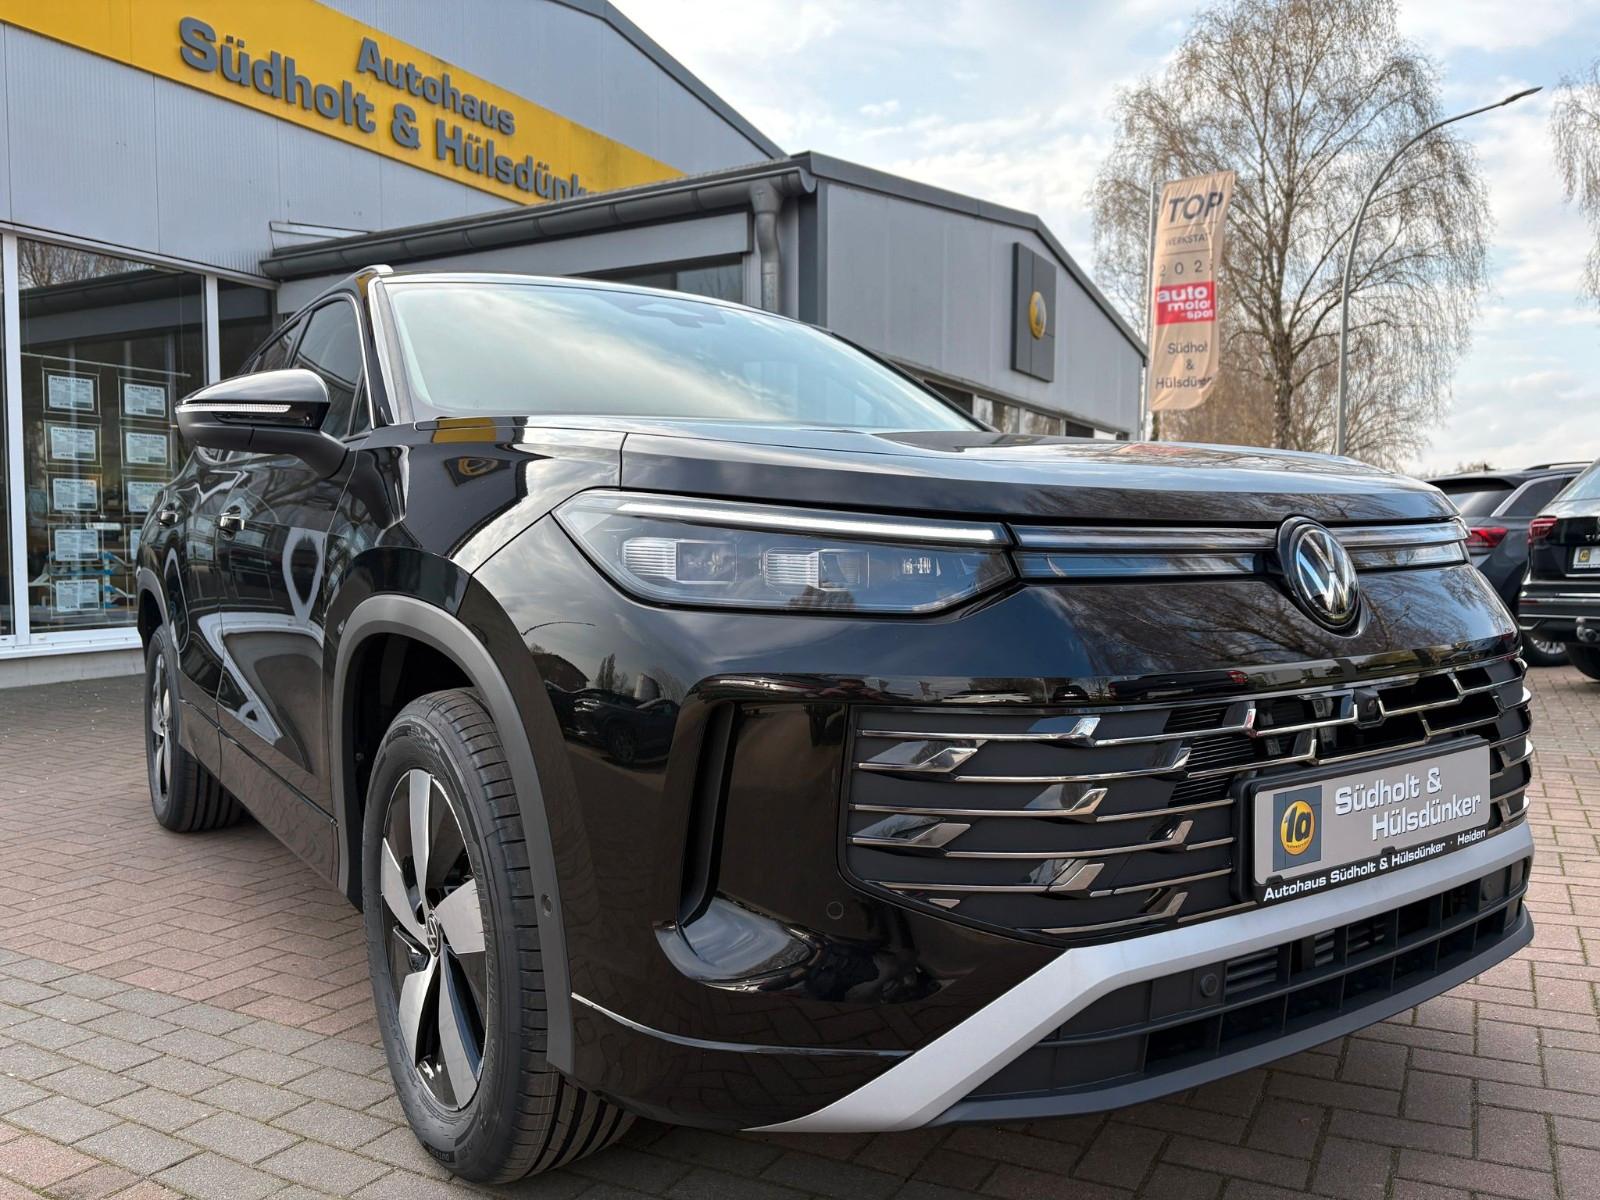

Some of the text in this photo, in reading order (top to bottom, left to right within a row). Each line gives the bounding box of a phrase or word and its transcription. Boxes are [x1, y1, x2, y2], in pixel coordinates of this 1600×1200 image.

[179, 16, 595, 201] Südholt & Hülsdünk
[357, 36, 516, 136] Autohaus
[1169, 192, 1223, 222] TOP
[1157, 286, 1208, 304] auto
[1168, 340, 1209, 355] Südhol
[1186, 359, 1195, 370] &
[1335, 767, 1442, 815] Südholt &
[1372, 794, 1481, 841] Hülsdünker
[1263, 876, 1328, 902] Autohaus
[1330, 862, 1376, 883] Südholt
[1379, 857, 1389, 870] &
[1391, 842, 1446, 867] Hülsdünker
[1457, 828, 1486, 846] Heiden
